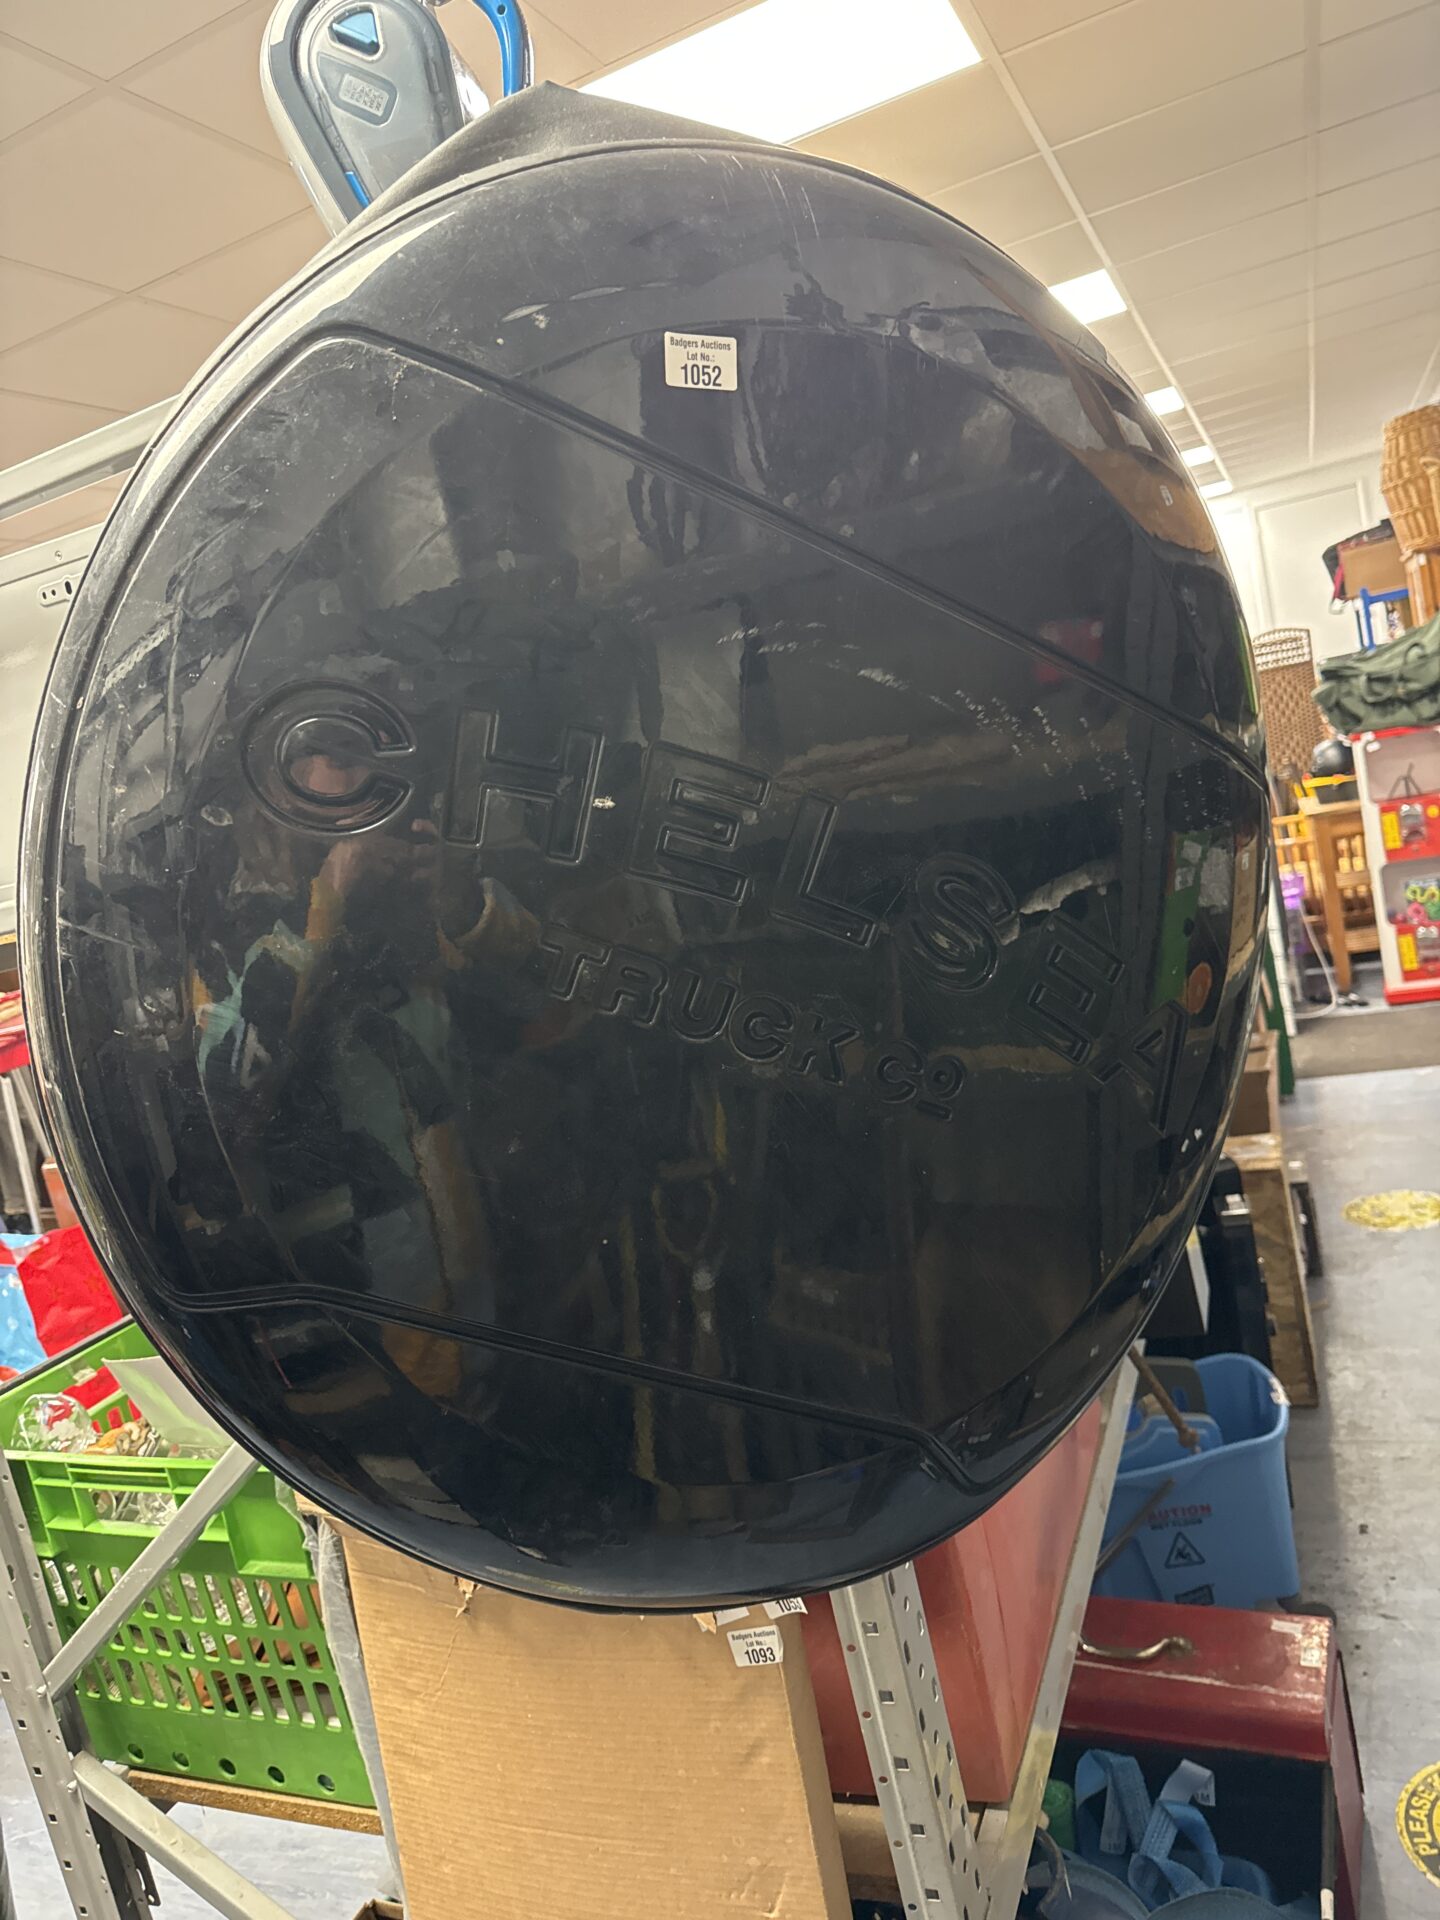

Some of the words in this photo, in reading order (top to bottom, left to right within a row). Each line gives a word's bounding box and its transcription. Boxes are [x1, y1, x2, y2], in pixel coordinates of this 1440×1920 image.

[670, 336, 699, 349] Badgers
[700, 339, 731, 351] Auctions
[686, 351, 698, 361] Lot
[680, 363, 722, 387] 1052
[239, 678, 1190, 1138] CHELSEA
[537, 922, 862, 1087] TRUCK
[1147, 1504, 1212, 1522] AUTION
[731, 1632, 753, 1641] Badgers
[753, 1630, 776, 1639] Auctions
[746, 1640, 755, 1648] Lot
[744, 1647, 776, 1664] 1093
[1408, 1786, 1439, 1856] PLEASE
